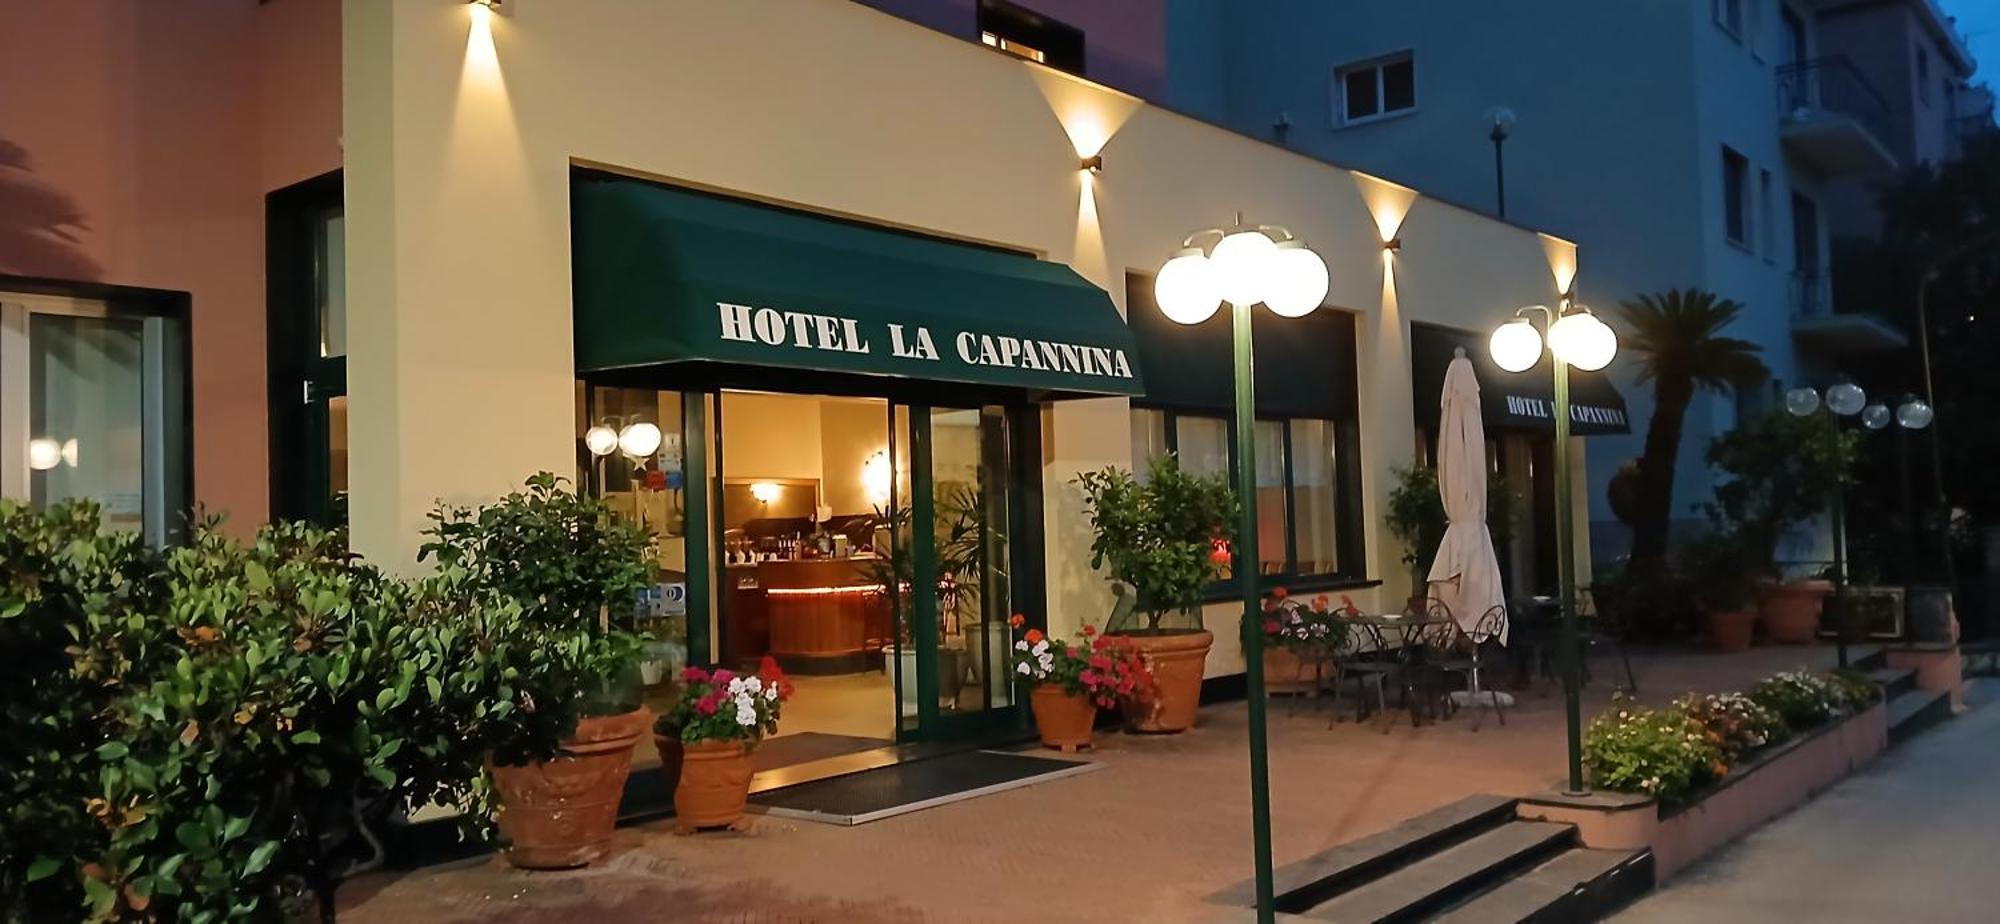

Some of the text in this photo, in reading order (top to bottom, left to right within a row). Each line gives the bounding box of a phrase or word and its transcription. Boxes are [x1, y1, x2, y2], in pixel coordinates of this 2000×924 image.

[716, 302, 1133, 378] HOTEL LA CAPANNINA
[1507, 395, 1548, 418] HOTEL
